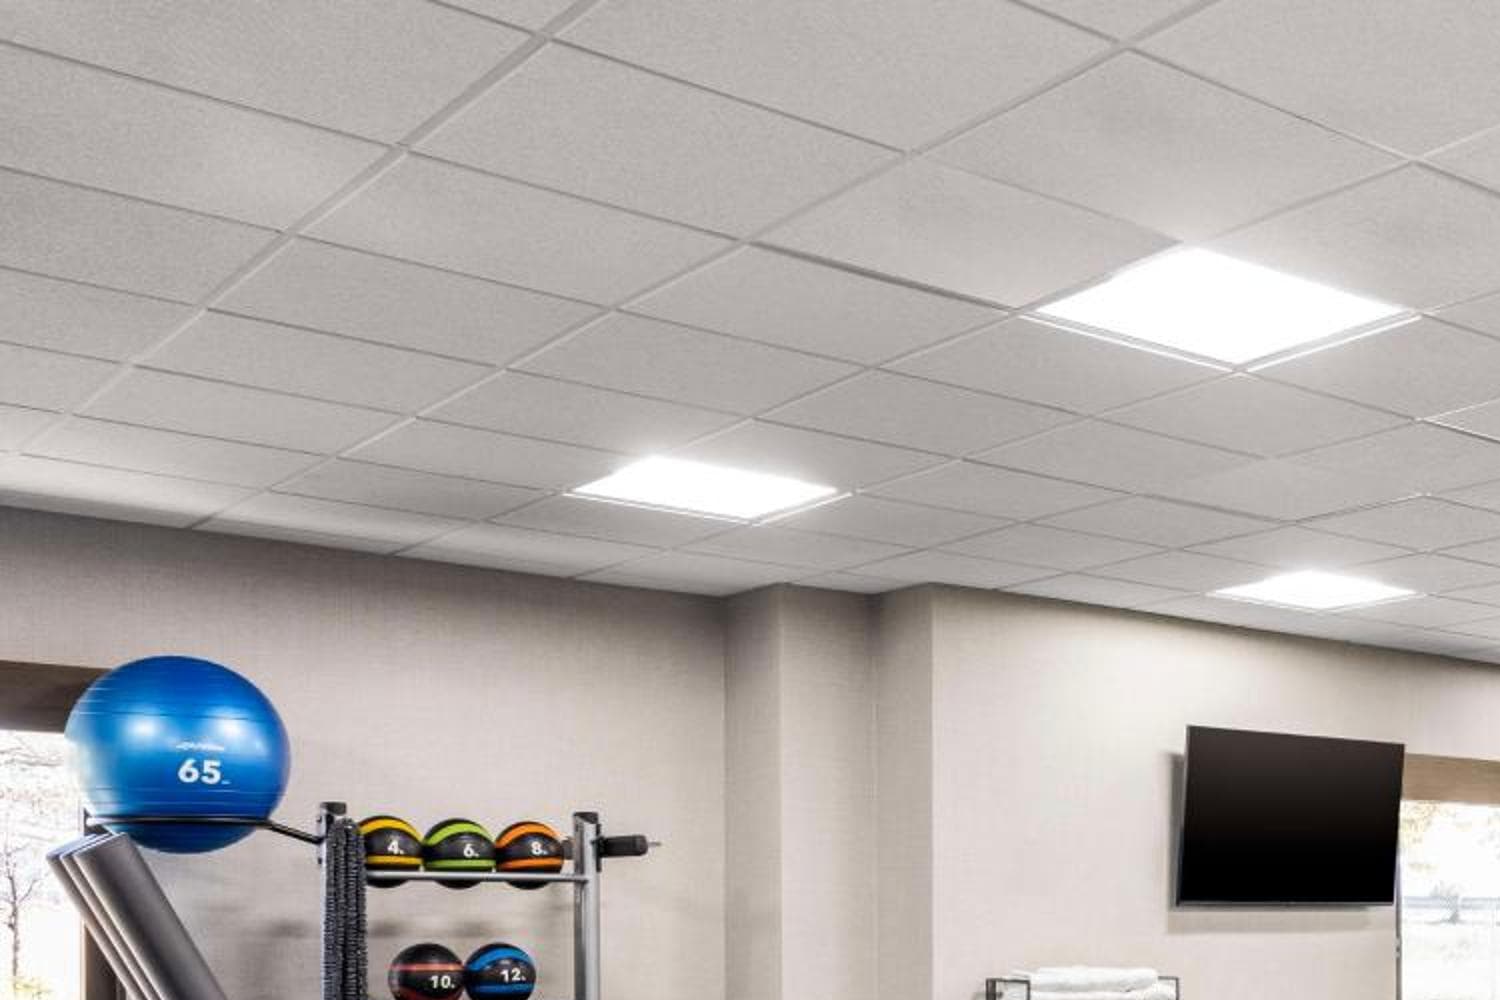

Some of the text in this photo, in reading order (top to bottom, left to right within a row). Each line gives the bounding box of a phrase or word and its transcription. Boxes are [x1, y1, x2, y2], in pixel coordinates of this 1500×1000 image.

[178, 758, 221, 784] 65
[387, 841, 399, 854] 4
[463, 844, 475, 857] 6
[530, 842, 543, 855] 8
[500, 967, 521, 982] 12
[430, 975, 451, 989] 10
